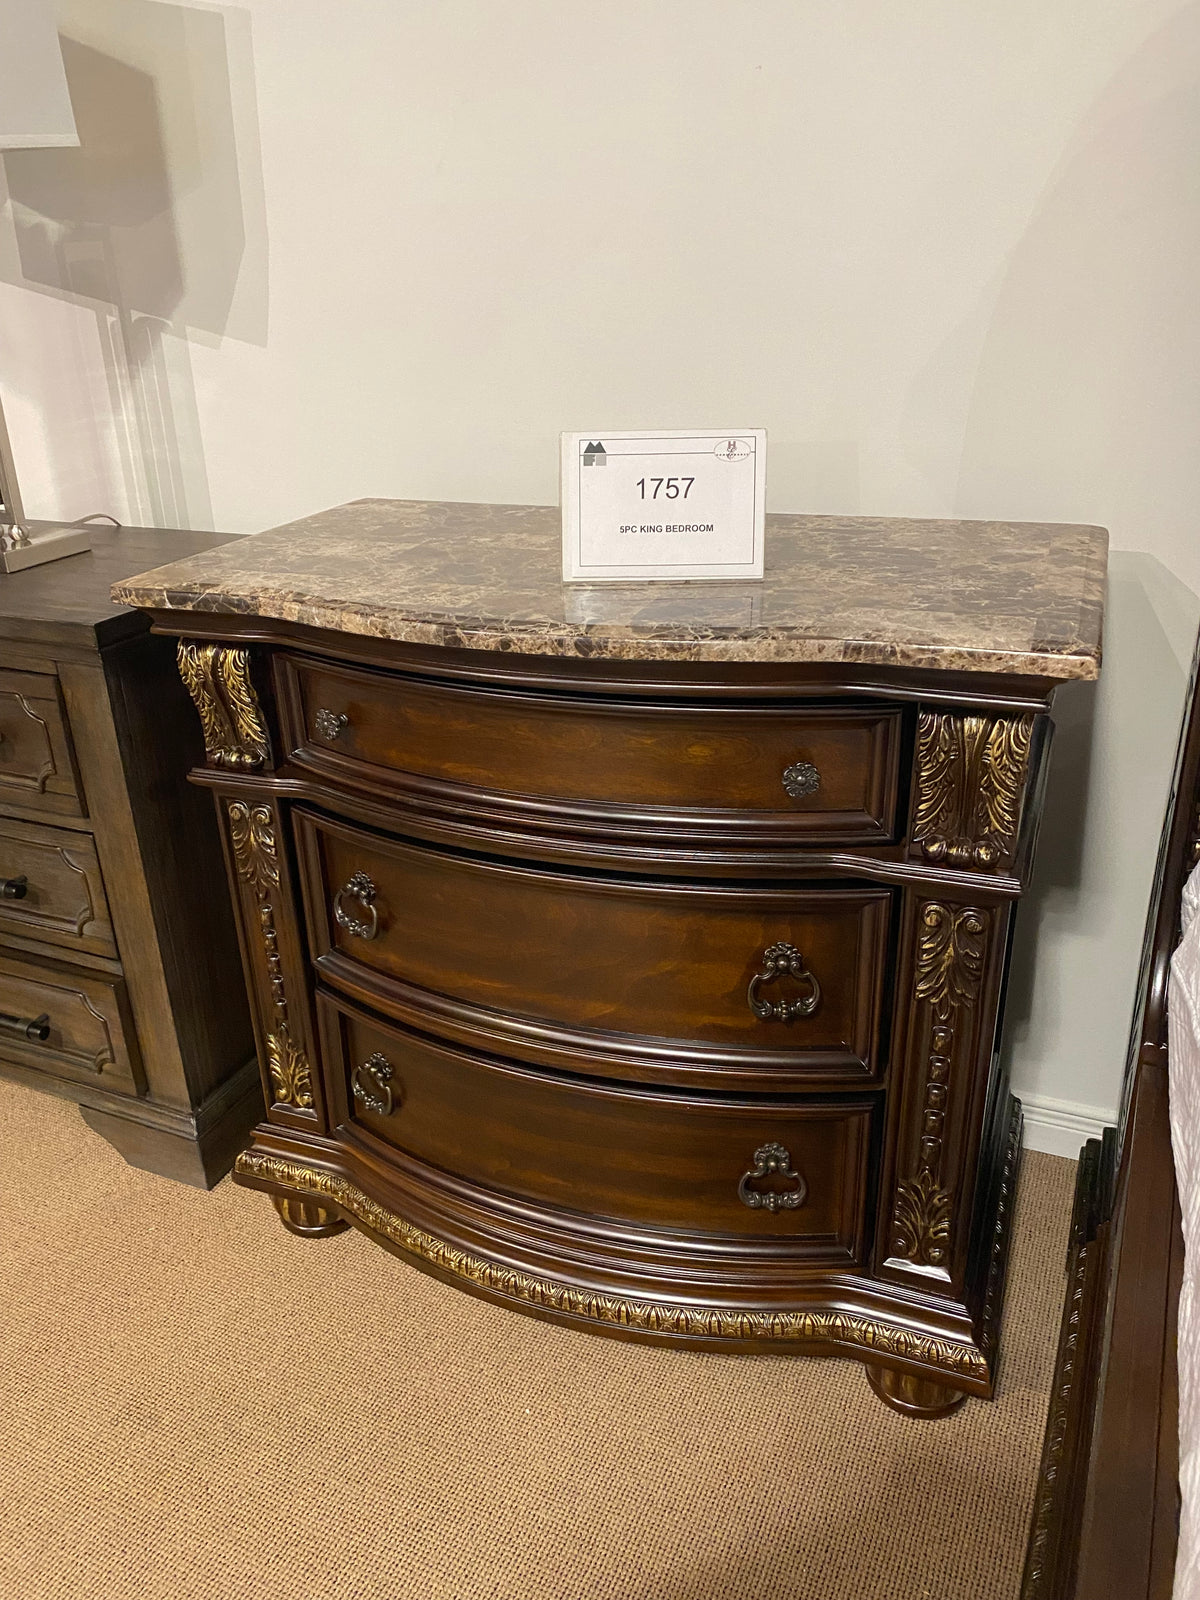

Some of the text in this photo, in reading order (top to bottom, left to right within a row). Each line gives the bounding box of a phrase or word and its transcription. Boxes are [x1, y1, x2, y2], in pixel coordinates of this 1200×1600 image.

[636, 477, 695, 500] 1757
[619, 524, 714, 534] 5PC KING BEDROOM
